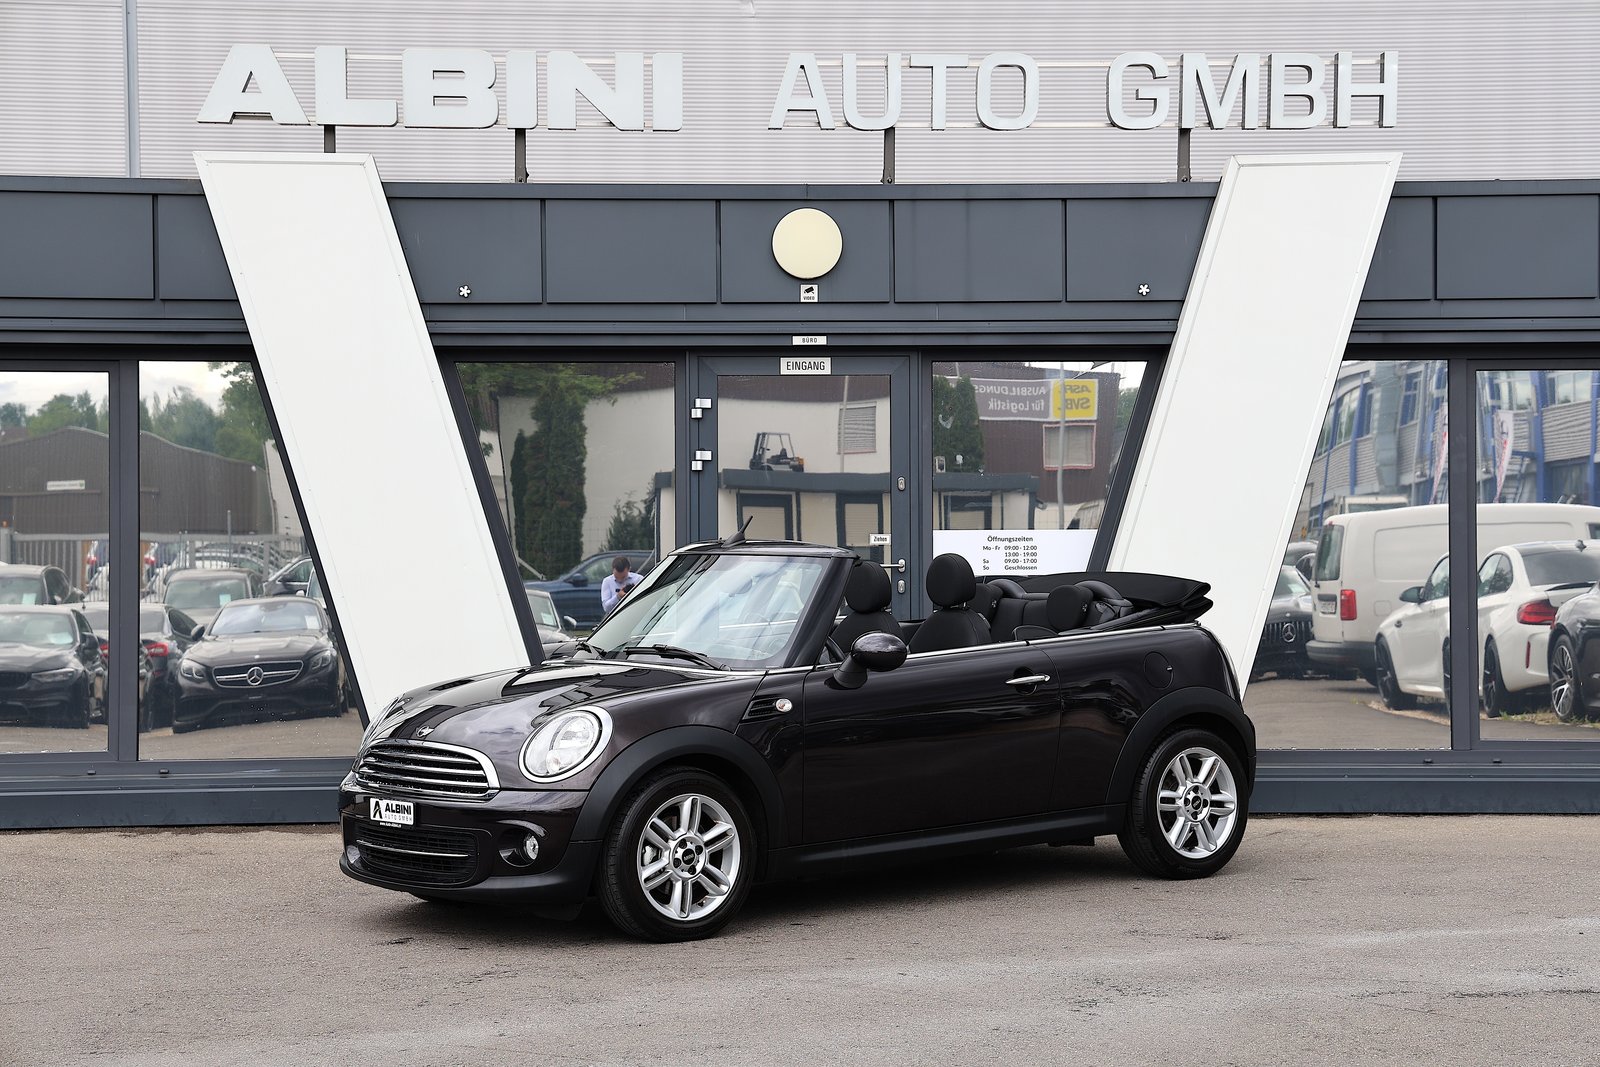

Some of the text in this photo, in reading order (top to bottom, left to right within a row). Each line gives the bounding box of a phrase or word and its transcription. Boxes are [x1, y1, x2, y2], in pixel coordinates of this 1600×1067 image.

[196, 43, 1399, 132] ALBINI AUTO GMBH
[786, 361, 826, 371] EINGANG
[987, 535, 1034, 543] Öffnungszeiten
[384, 802, 412, 816] ALBINI
